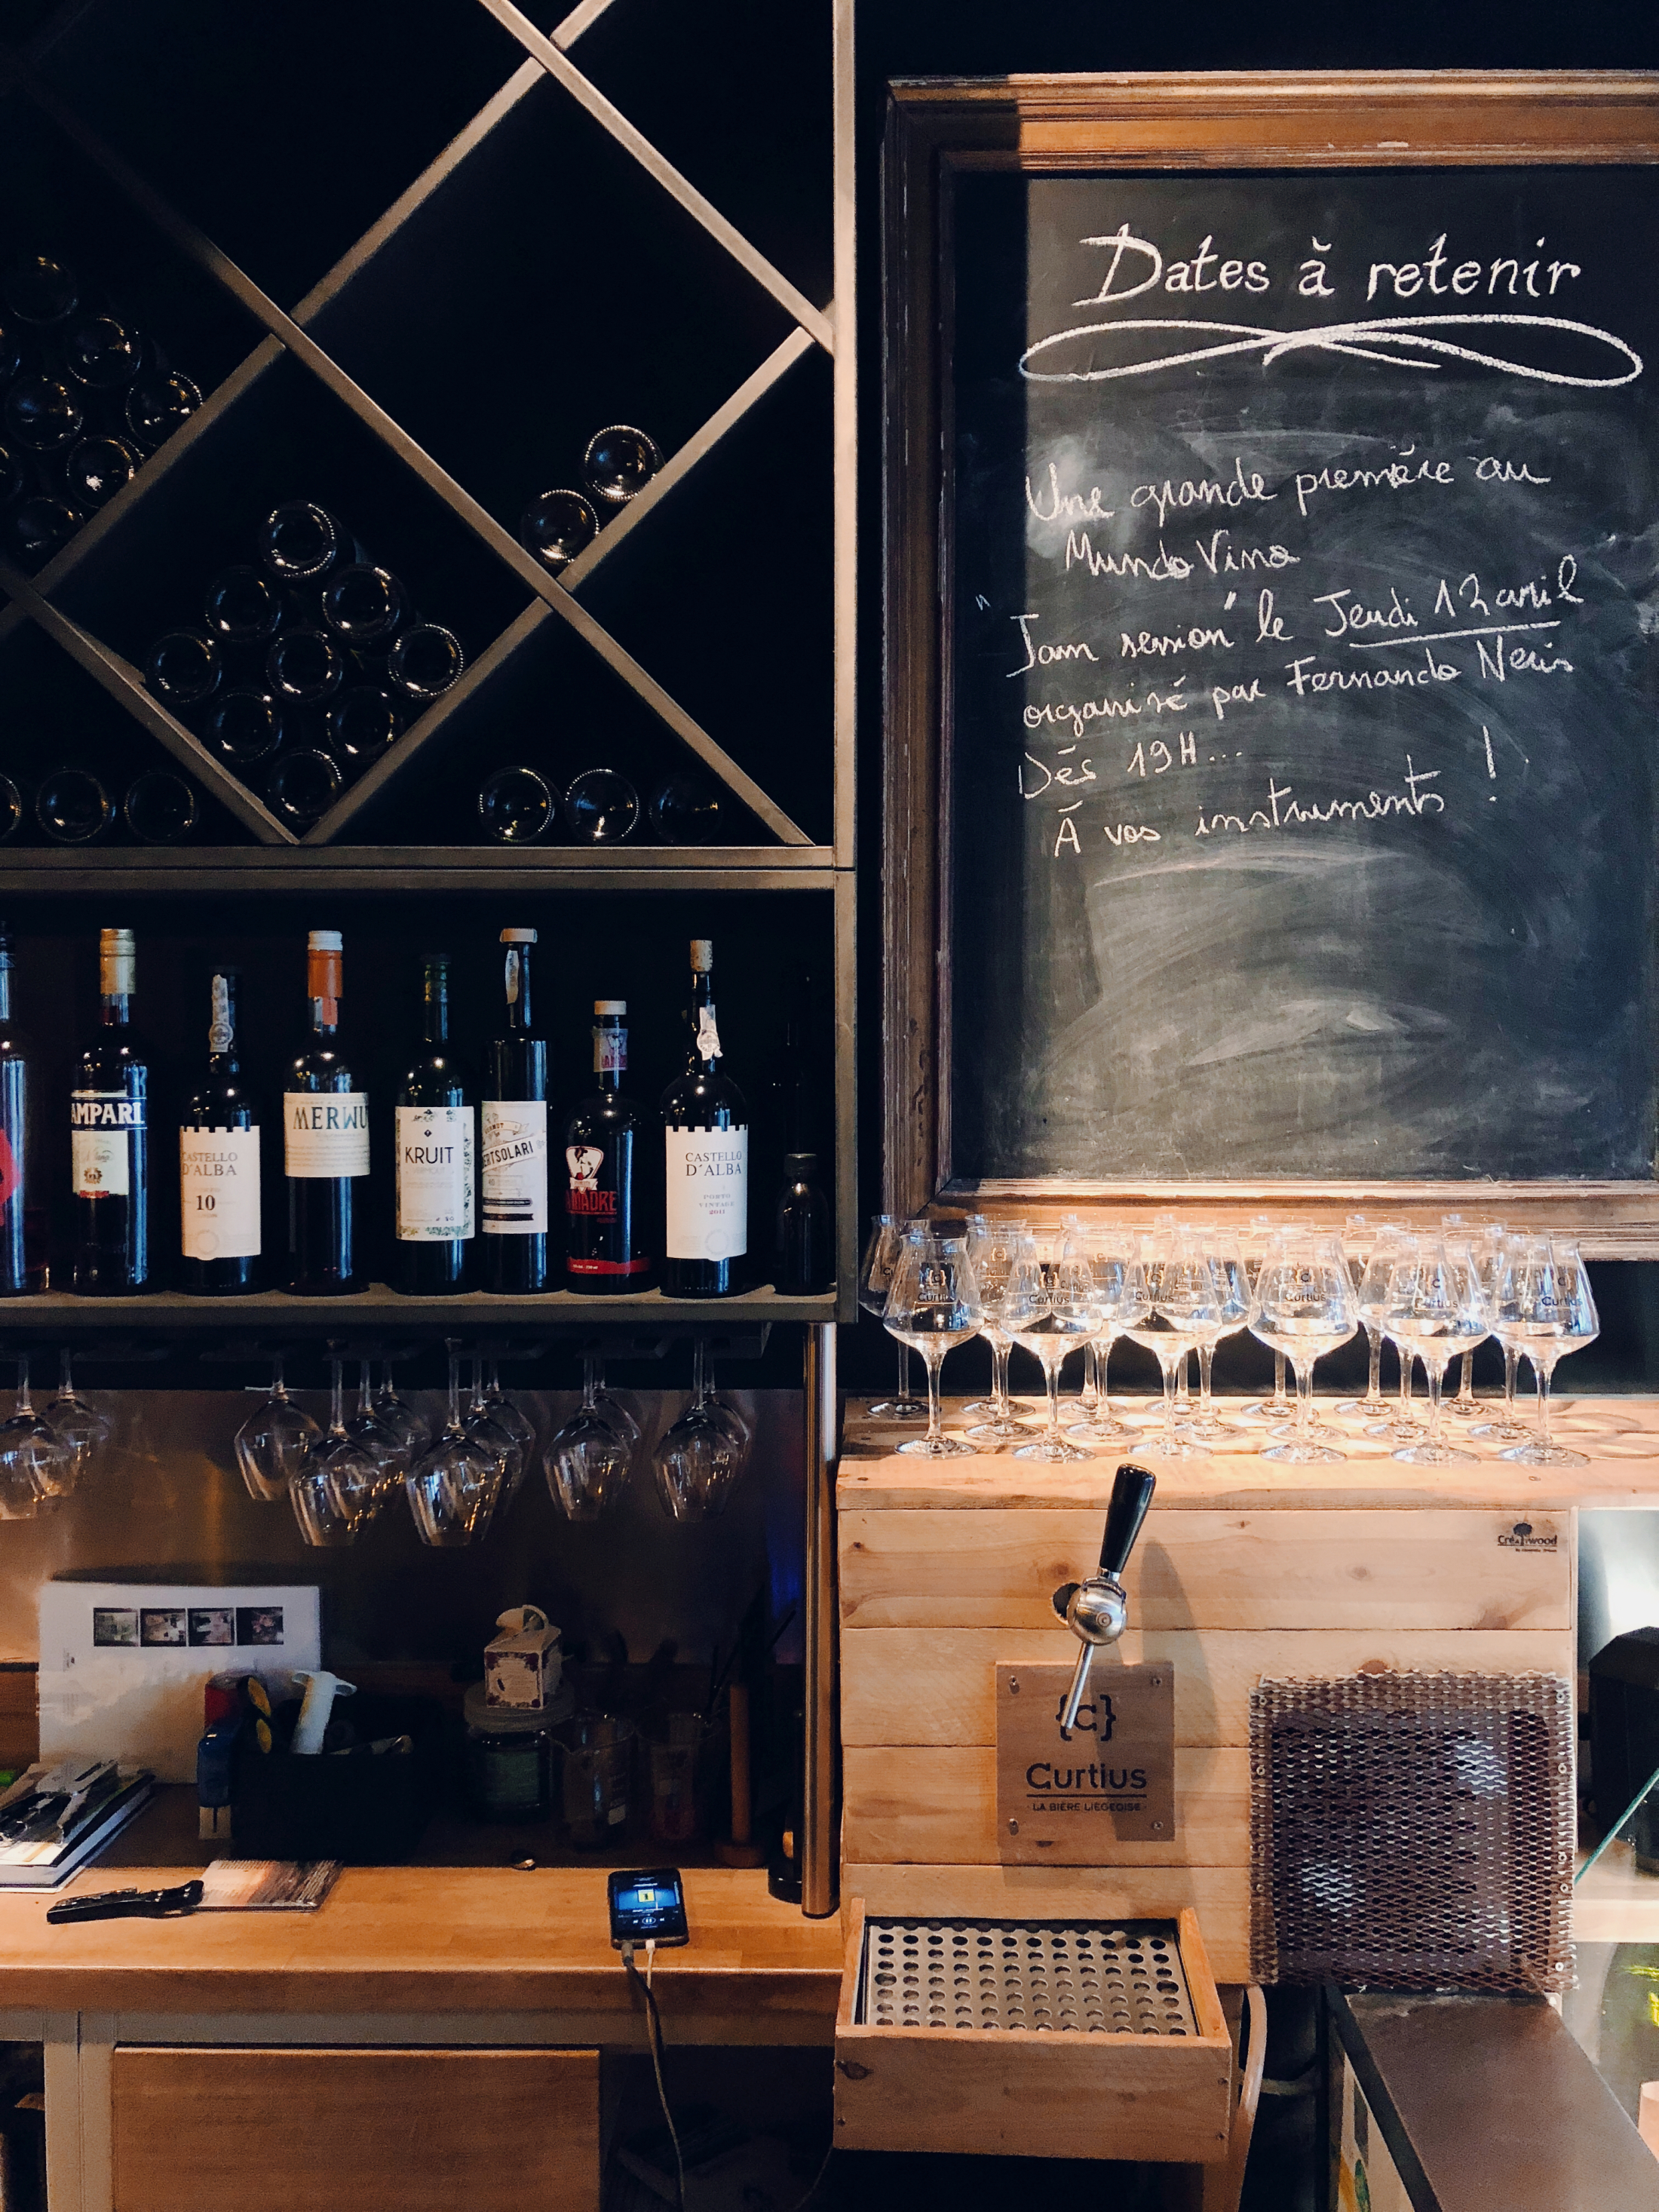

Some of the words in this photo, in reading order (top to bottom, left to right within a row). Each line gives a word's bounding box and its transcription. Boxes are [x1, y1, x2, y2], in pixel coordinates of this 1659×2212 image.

[1071, 223, 1271, 306] Dates
[1366, 232, 1581, 301] retenir
[1026, 462, 1115, 521] Une
[1131, 456, 1278, 528] grande
[1467, 456, 1552, 484] au
[1256, 588, 1294, 643] le
[1314, 588, 1418, 637] Jeudi
[1211, 678, 1267, 720] par
[1285, 646, 1462, 696] Fernando
[1103, 824, 1162, 845] vos
[1194, 753, 1445, 836] instruments
[405, 1146, 454, 1164] KRUIT
[685, 1151, 742, 1162] CASTELLO
[196, 1195, 216, 1211] 10
[1026, 1762, 1148, 1790] Curtius
[1032, 1802, 1047, 1812] LA
